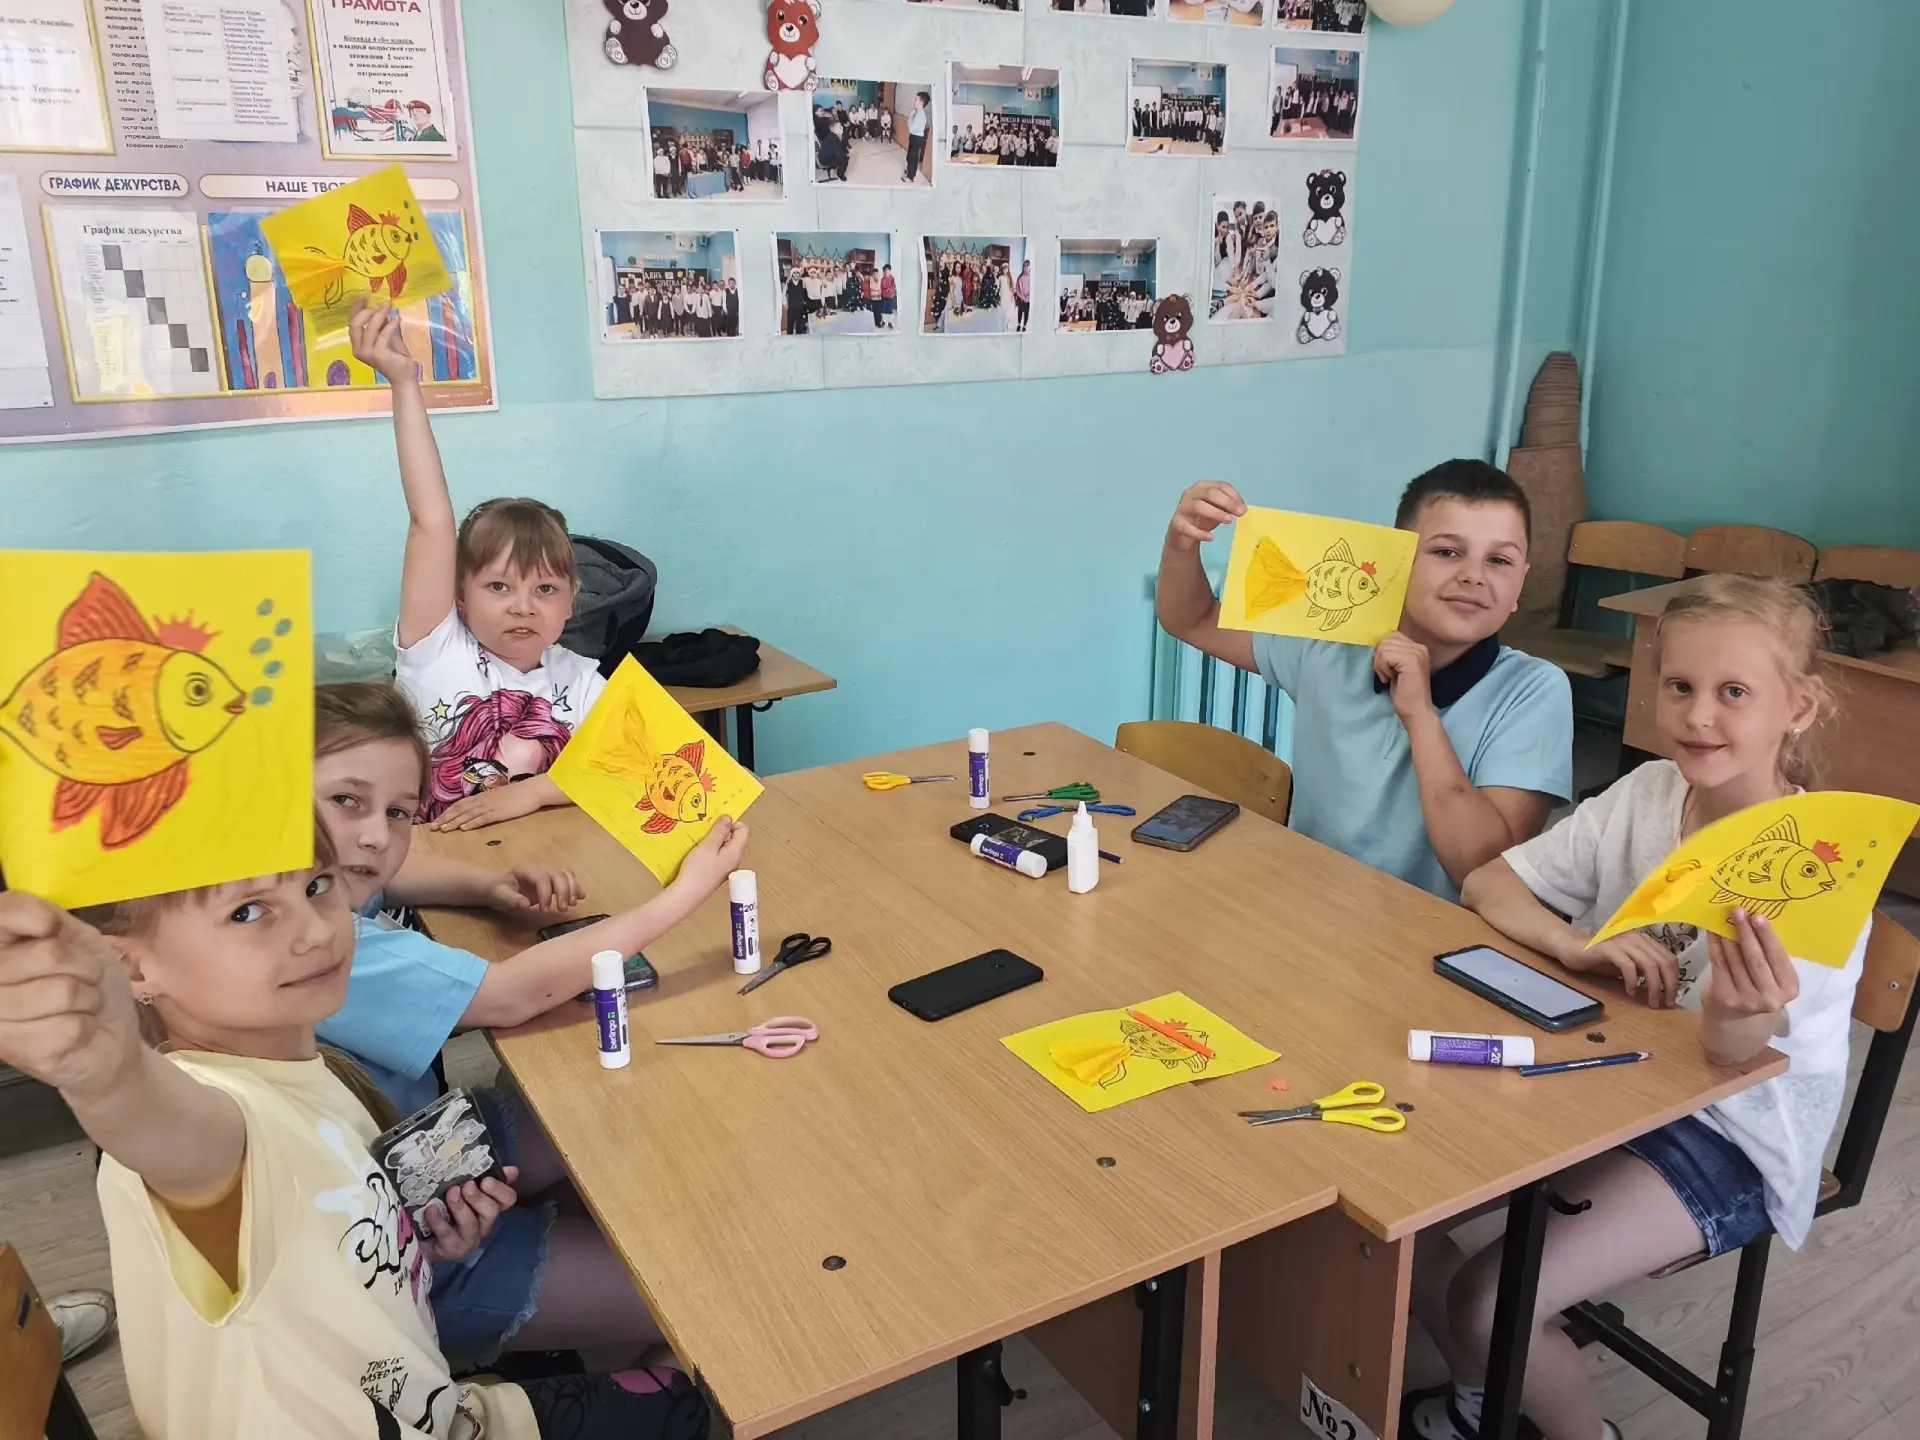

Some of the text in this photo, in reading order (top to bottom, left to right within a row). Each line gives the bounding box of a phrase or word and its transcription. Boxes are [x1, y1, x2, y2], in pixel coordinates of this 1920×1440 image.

[331, 0, 422, 13] ГРАМОТА
[49, 177, 181, 192] ГРАФИК ДЕЖУРСТВА
[265, 180, 308, 193] НАШЕ
[83, 225, 183, 237] График дежурства
[981, 845, 1000, 858] berlingo
[736, 929, 744, 957] berlingo
[608, 1019, 618, 1050] berlingo
